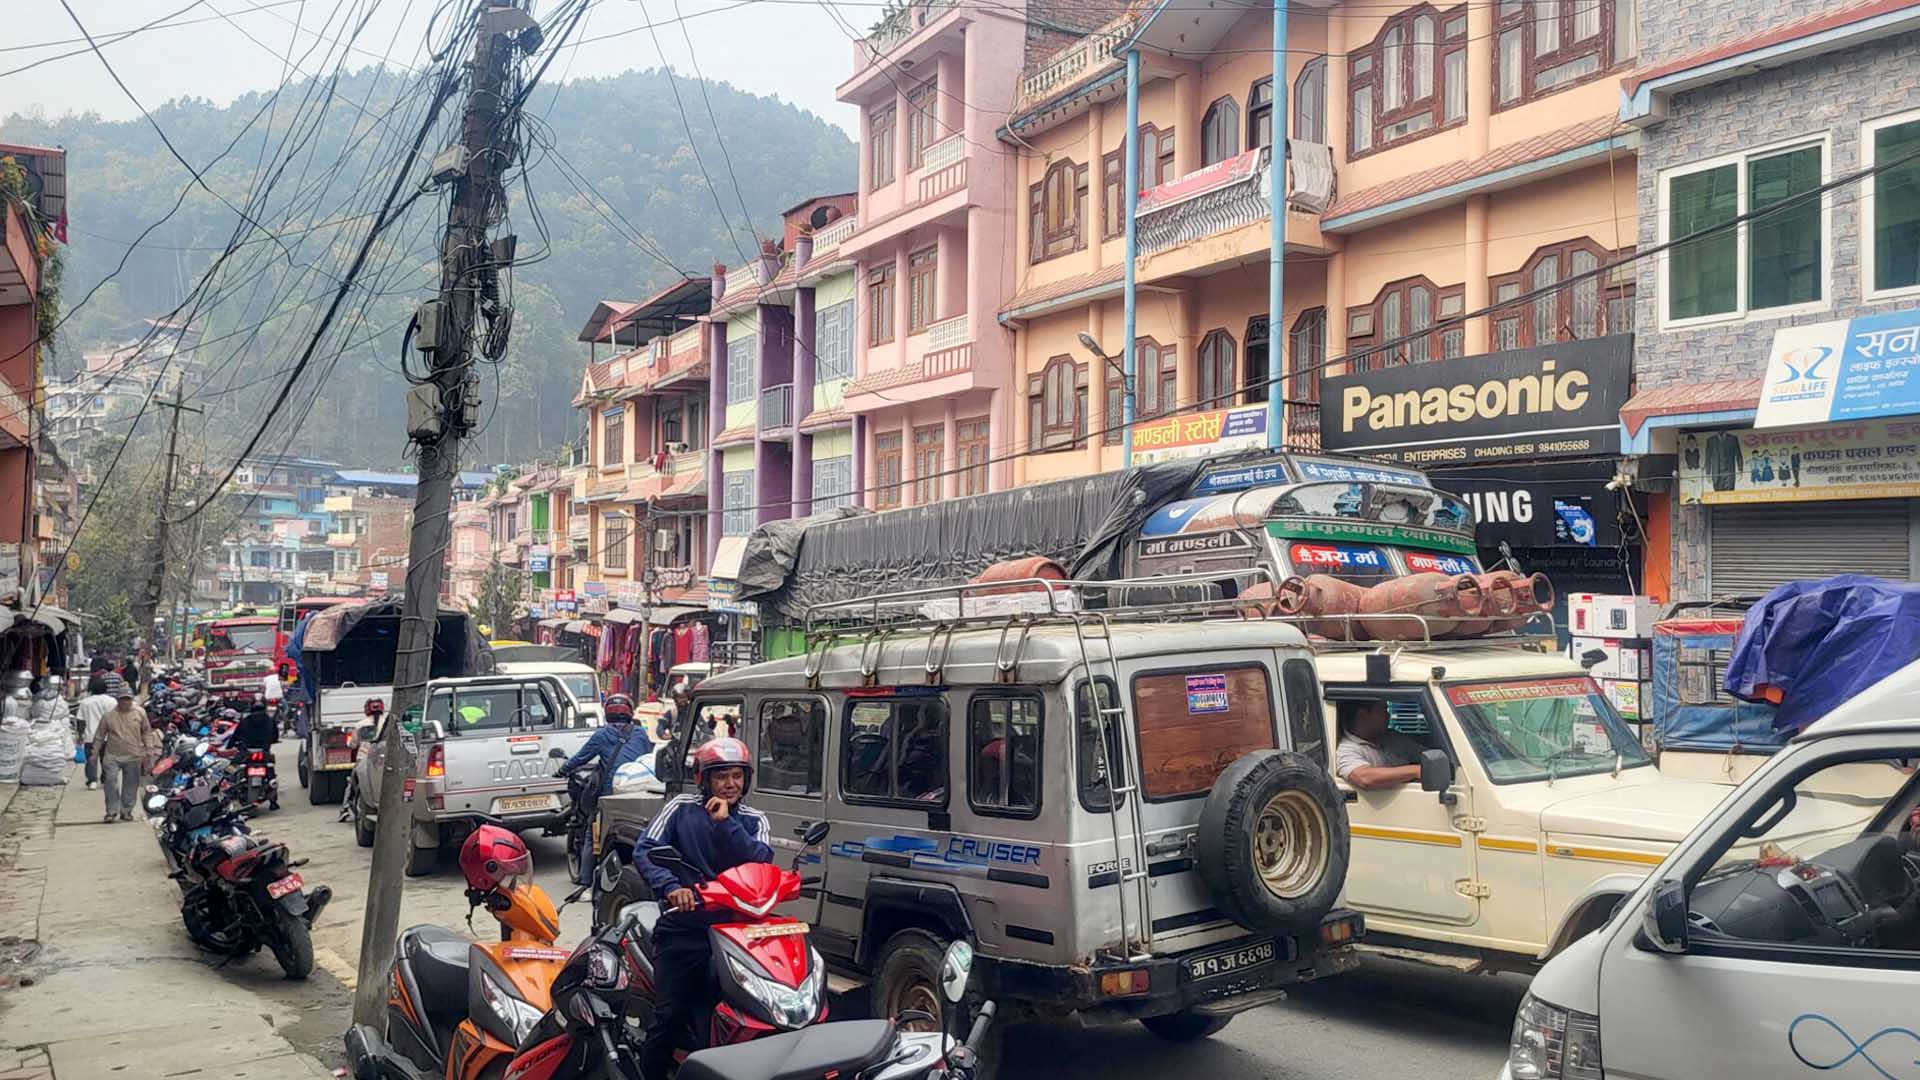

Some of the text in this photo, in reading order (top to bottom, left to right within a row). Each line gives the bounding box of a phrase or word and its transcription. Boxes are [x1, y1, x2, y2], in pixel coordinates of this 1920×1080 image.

[1343, 359, 1590, 433] Panasonic
[1800, 381, 1828, 392] LIFE
[1133, 419, 1181, 447] मण्डली
[1403, 447, 1467, 462] ENTERPRISES
[1474, 444, 1513, 457] DHADING
[1514, 443, 1535, 454] BESI
[1538, 439, 1590, 453] 9841055688
[1168, 531, 1233, 552] मण्डली
[1314, 549, 1350, 565] जय
[1410, 554, 1461, 573] मण्डली
[488, 757, 562, 782] TATA
[947, 837, 1041, 866] CRUISER
